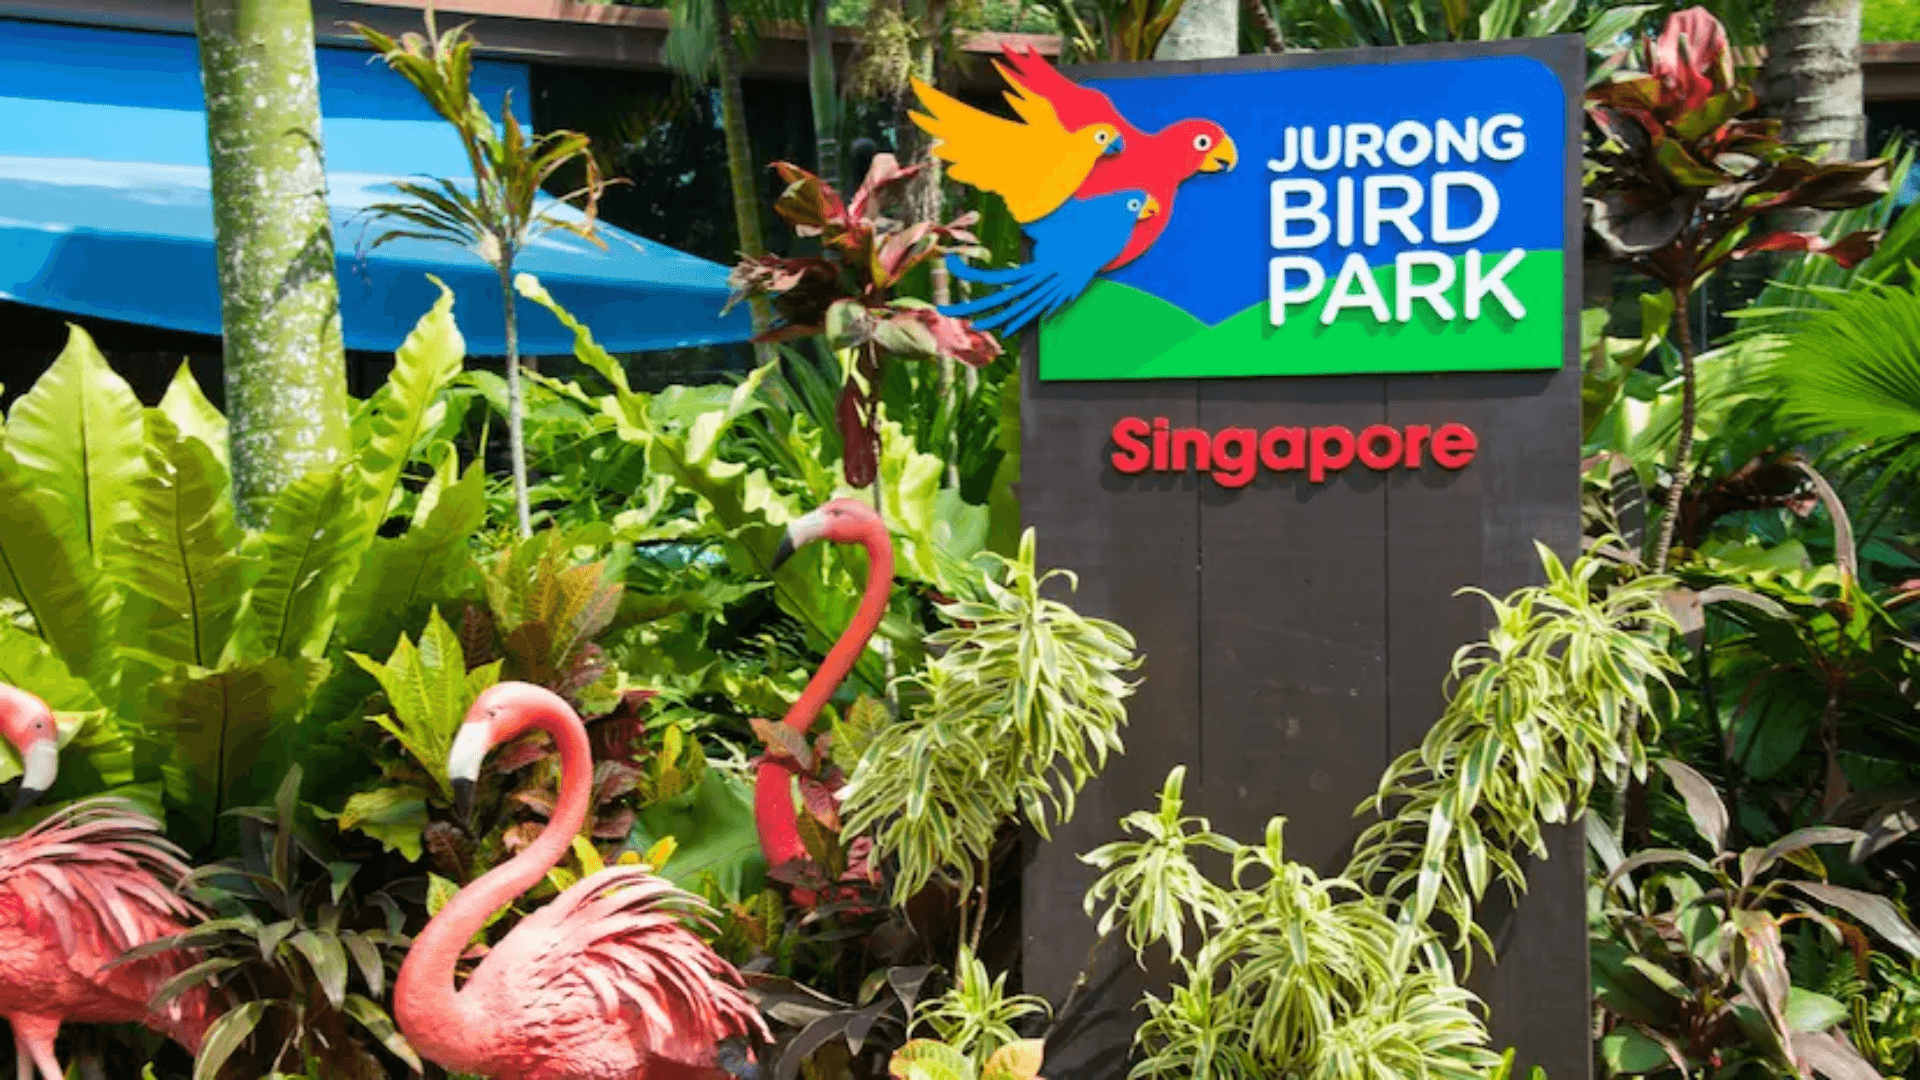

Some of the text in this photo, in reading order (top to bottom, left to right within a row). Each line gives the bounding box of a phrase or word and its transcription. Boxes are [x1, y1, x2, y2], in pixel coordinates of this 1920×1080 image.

[1267, 113, 1526, 172] JURONG
[1269, 171, 1500, 249] BIRD
[1268, 248, 1527, 327] PARK
[1110, 416, 1479, 488] Singapore
